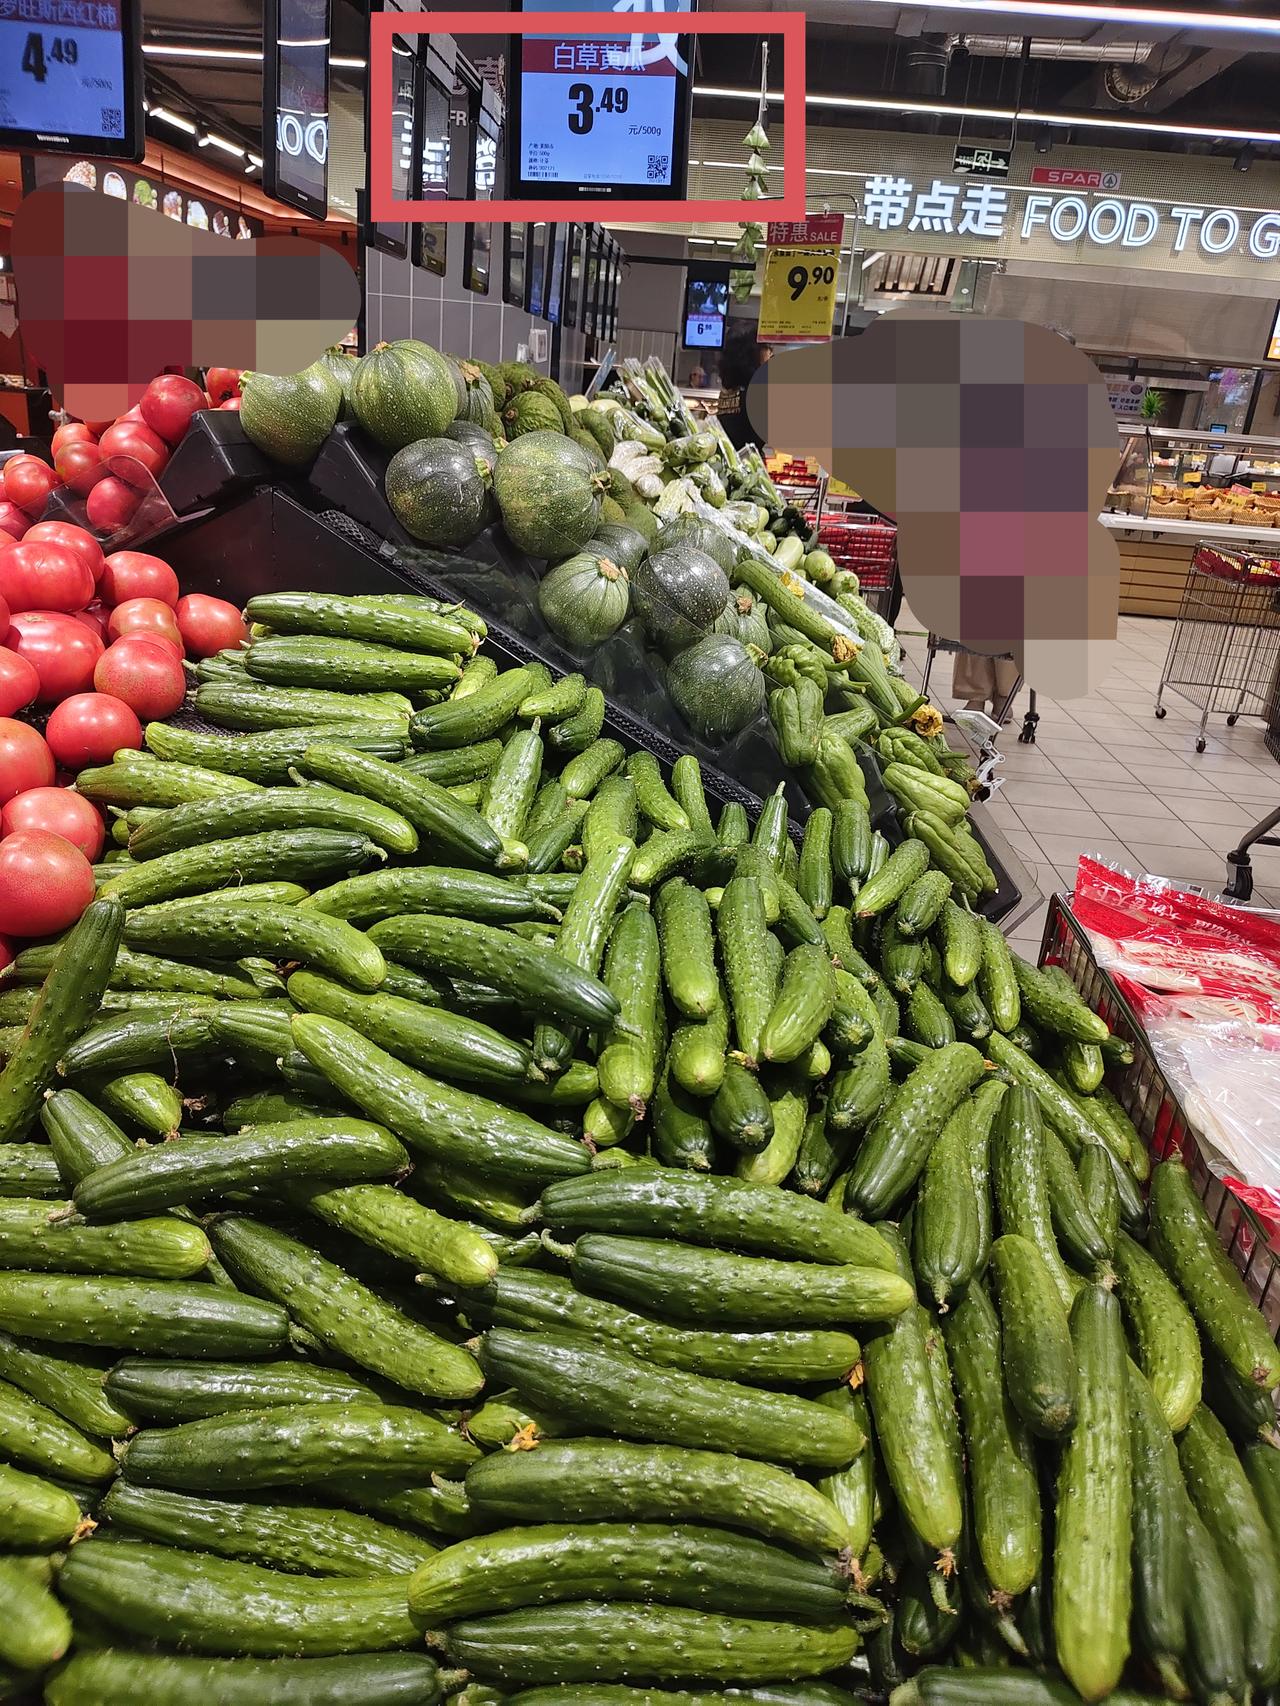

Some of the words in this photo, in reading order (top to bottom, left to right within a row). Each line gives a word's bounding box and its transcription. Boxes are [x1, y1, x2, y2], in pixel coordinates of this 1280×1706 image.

[22, 32, 78, 83] 4.49
[554, 43, 646, 72] 白草黄瓜
[568, 83, 629, 135] 3.49
[628, 124, 662, 136] 元/500g
[1047, 171, 1100, 187] SPAR
[863, 175, 1009, 239] 带点走
[1020, 194, 1159, 247] FOOD
[1170, 207, 1240, 254] TO
[810, 231, 838, 242] SALE
[788, 265, 835, 302] 9.90
